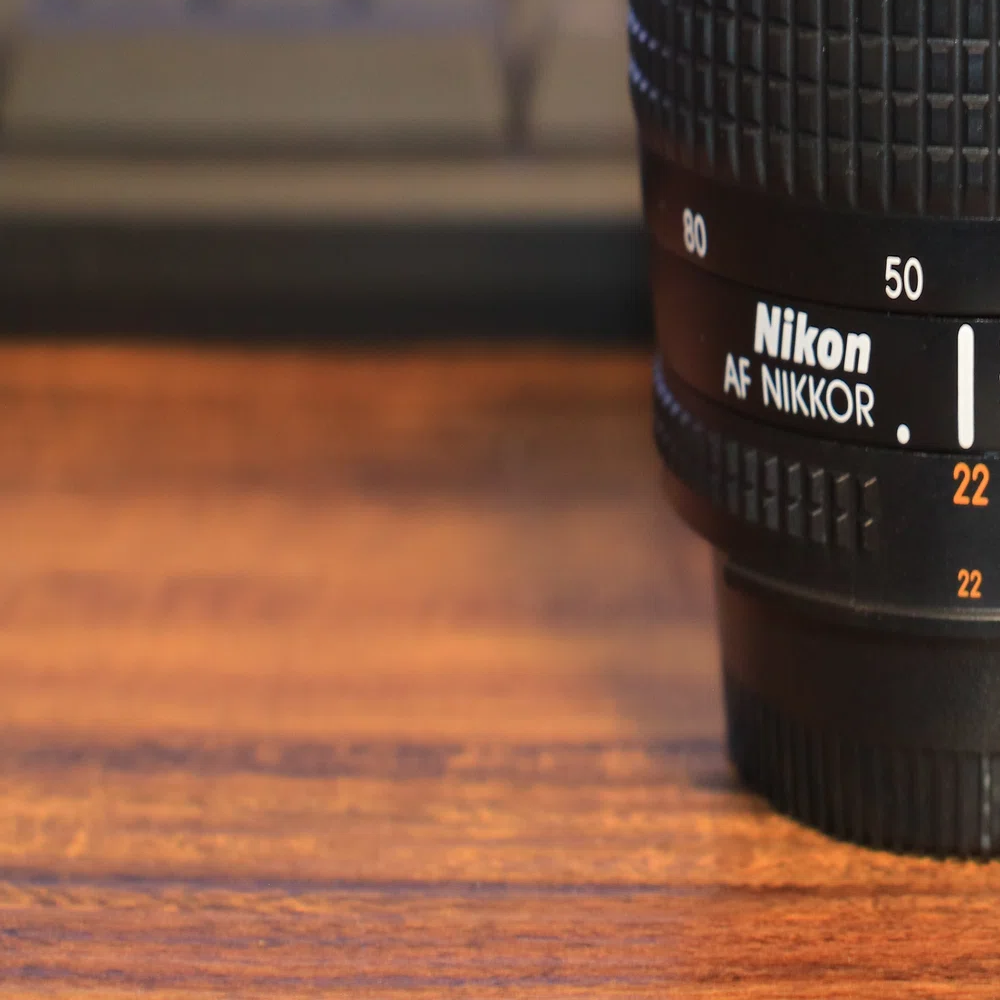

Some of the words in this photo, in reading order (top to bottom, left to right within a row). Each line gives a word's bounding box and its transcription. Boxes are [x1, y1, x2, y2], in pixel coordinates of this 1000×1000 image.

[682, 208, 707, 258] 80
[885, 255, 924, 301] 50
[754, 301, 872, 374] Nikon
[723, 353, 752, 399] AF
[761, 363, 875, 428] NIKKOR
[952, 461, 990, 507] 22
[957, 568, 983, 599] 22
